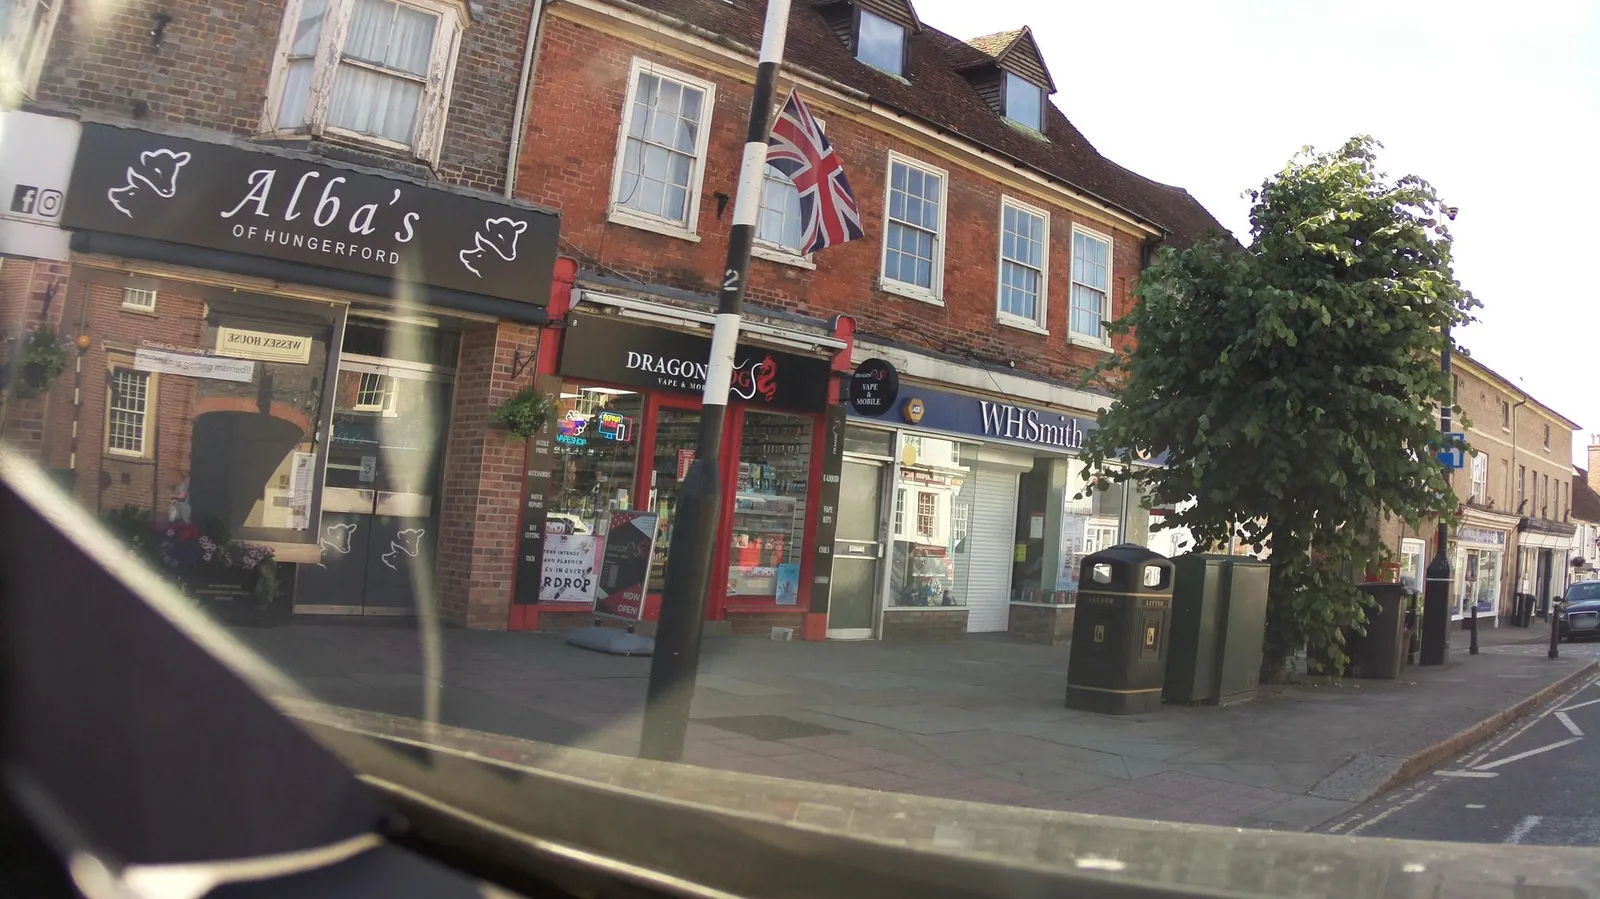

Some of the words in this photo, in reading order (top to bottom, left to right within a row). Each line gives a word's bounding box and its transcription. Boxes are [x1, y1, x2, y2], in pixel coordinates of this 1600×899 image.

[220, 169, 420, 243] Alba's
[232, 224, 259, 240] OF
[264, 229, 400, 265] HUNGERFORD
[723, 269, 740, 291] 2
[626, 351, 708, 381] DRAGON
[658, 378, 679, 387] VAPE
[681, 380, 687, 388] &
[862, 383, 879, 391] VAPE
[856, 398, 882, 406] MOBILE
[980, 400, 1085, 450] WHSmith
[623, 591, 641, 602] NOW
